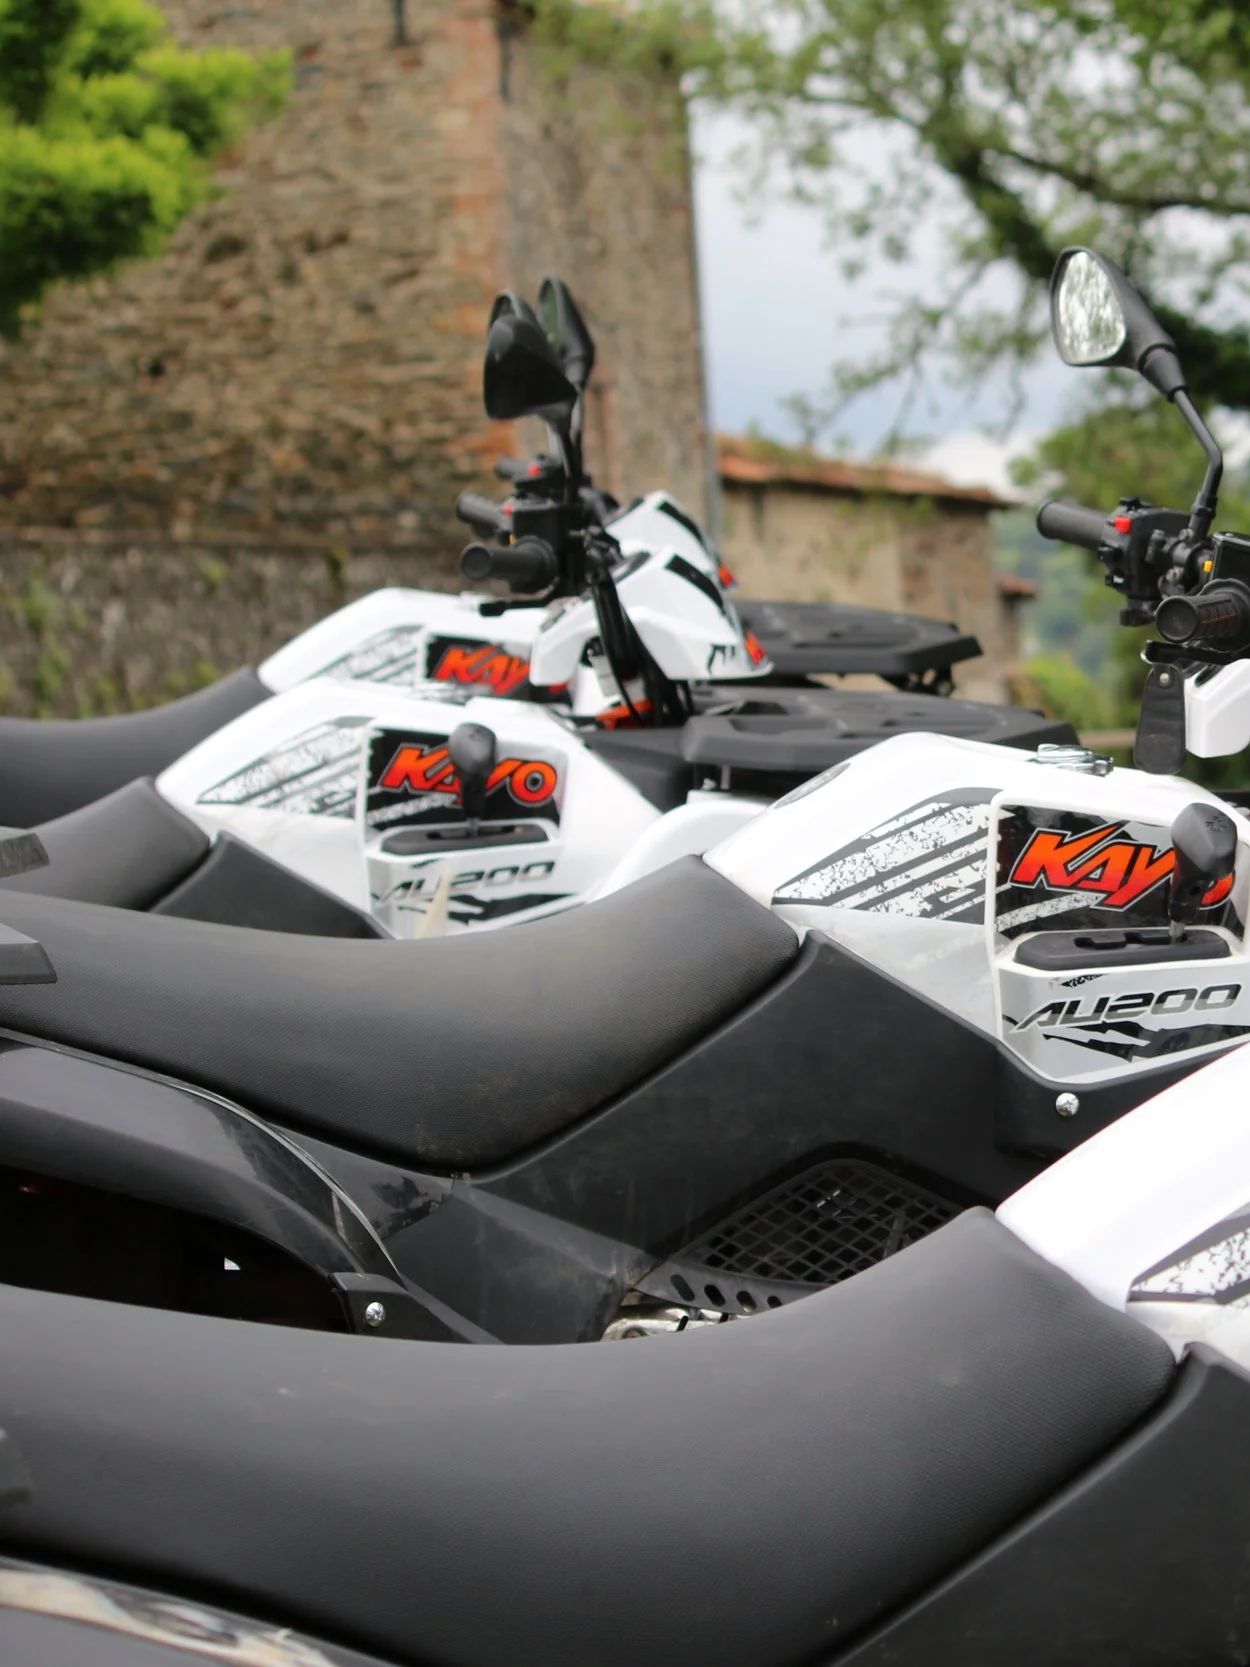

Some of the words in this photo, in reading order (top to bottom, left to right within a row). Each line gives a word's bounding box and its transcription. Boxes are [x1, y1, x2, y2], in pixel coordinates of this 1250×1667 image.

[435, 645, 567, 695] KAY
[1009, 822, 1236, 911] KAY
[1010, 984, 1242, 1033] AU200
